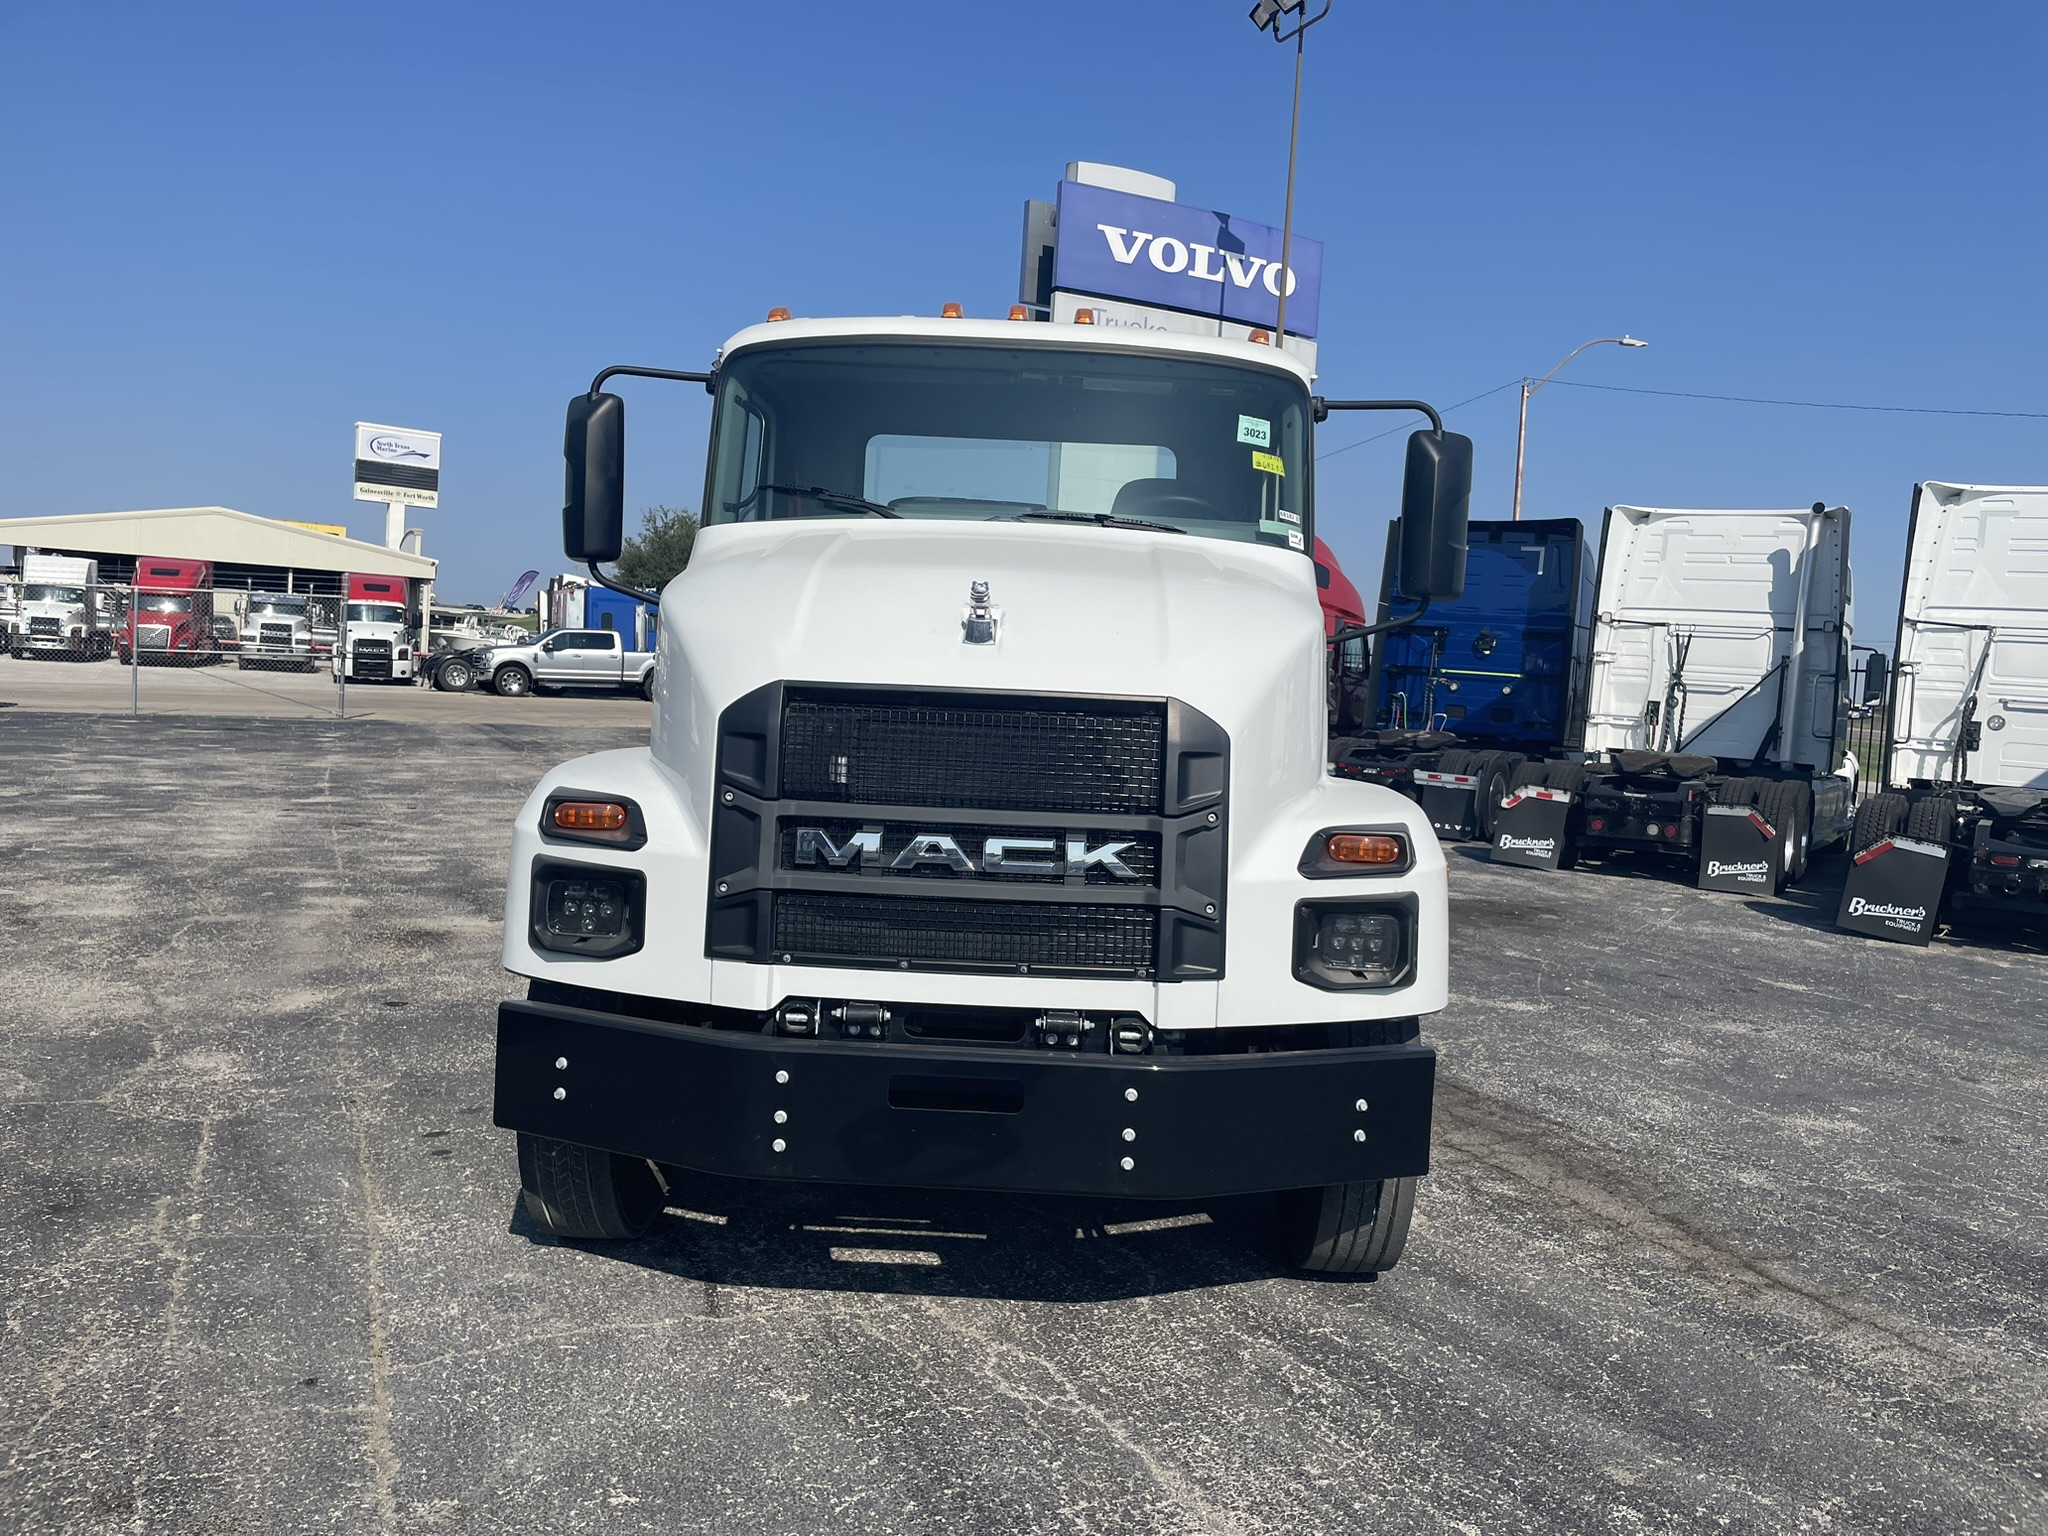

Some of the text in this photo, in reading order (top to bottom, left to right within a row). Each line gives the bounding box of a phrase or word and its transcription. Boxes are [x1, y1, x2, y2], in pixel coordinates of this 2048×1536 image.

[1097, 223, 1297, 298] VOLVO
[1092, 307, 1167, 331] Truk
[1243, 427, 1267, 440] 3023
[376, 440, 394, 448] North
[376, 445, 398, 453] Marine
[360, 487, 394, 496] Gainesville
[416, 493, 435, 501] Worth
[1434, 822, 1471, 832] OLVO
[1499, 834, 1555, 850] Bruckner's
[796, 827, 1140, 878] MACK
[1707, 860, 1769, 877] Bruckner's
[1848, 897, 1926, 916] Bruckner's
[1885, 920, 1921, 933] EQUIPMENT
[1896, 918, 1916, 927] TRUCK
